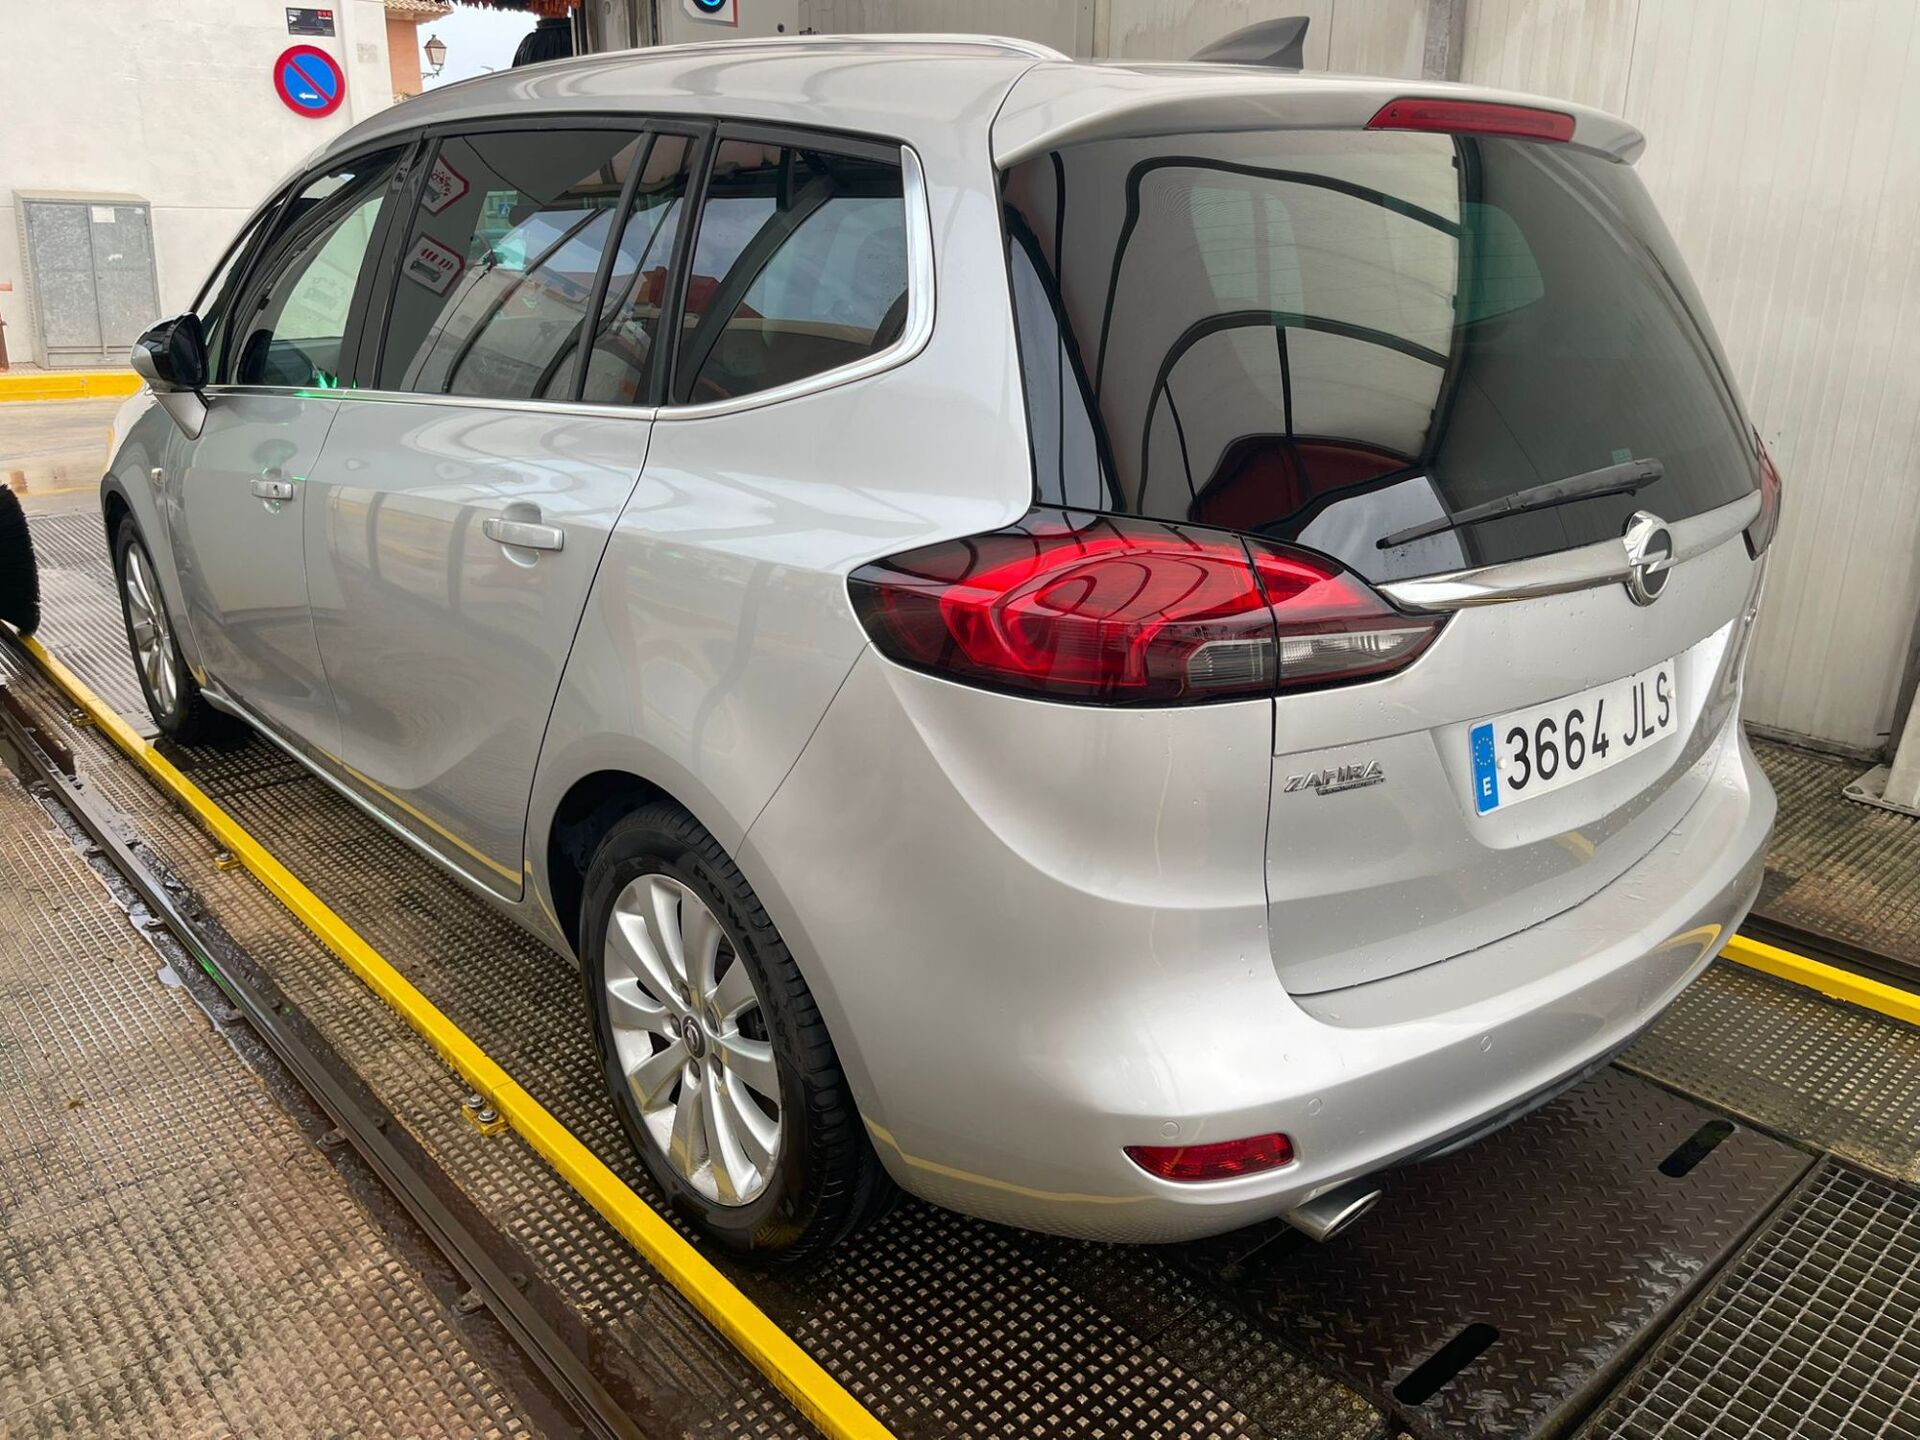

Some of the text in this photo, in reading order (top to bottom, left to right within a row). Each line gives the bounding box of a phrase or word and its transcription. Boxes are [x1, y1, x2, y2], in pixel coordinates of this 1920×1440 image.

[1506, 671, 1670, 790] 3664 JLS
[1284, 760, 1383, 793] ZAFIRA
[1482, 776, 1492, 797] E
